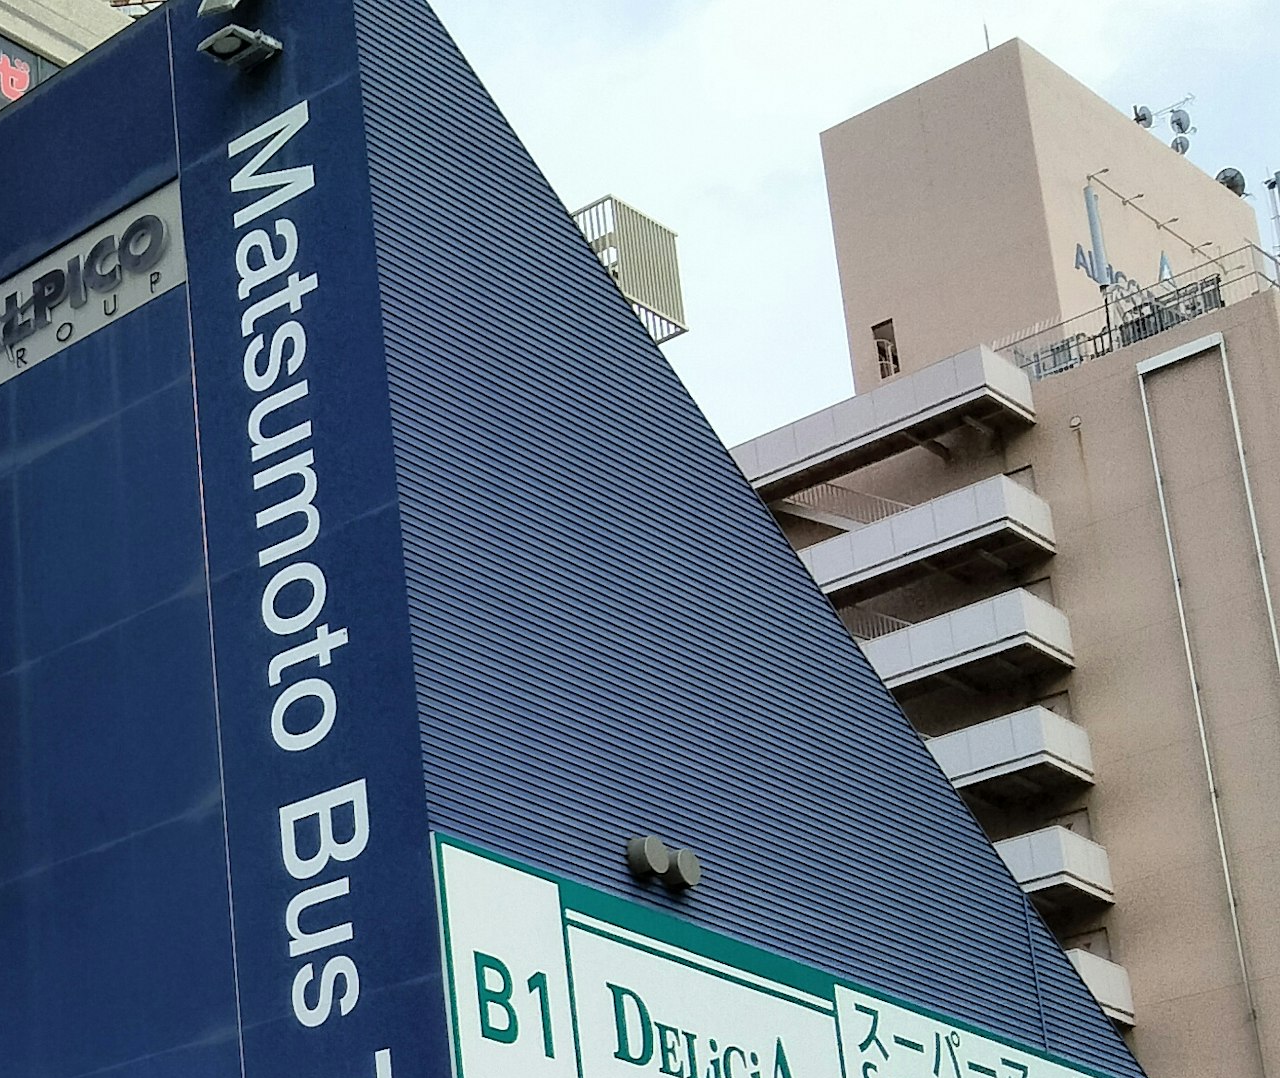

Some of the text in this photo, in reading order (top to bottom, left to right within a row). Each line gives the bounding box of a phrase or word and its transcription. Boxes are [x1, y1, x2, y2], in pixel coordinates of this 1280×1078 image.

[227, 101, 348, 752] Matsumoto
[279, 779, 370, 1028] Bus
[473, 951, 557, 1059] B1
